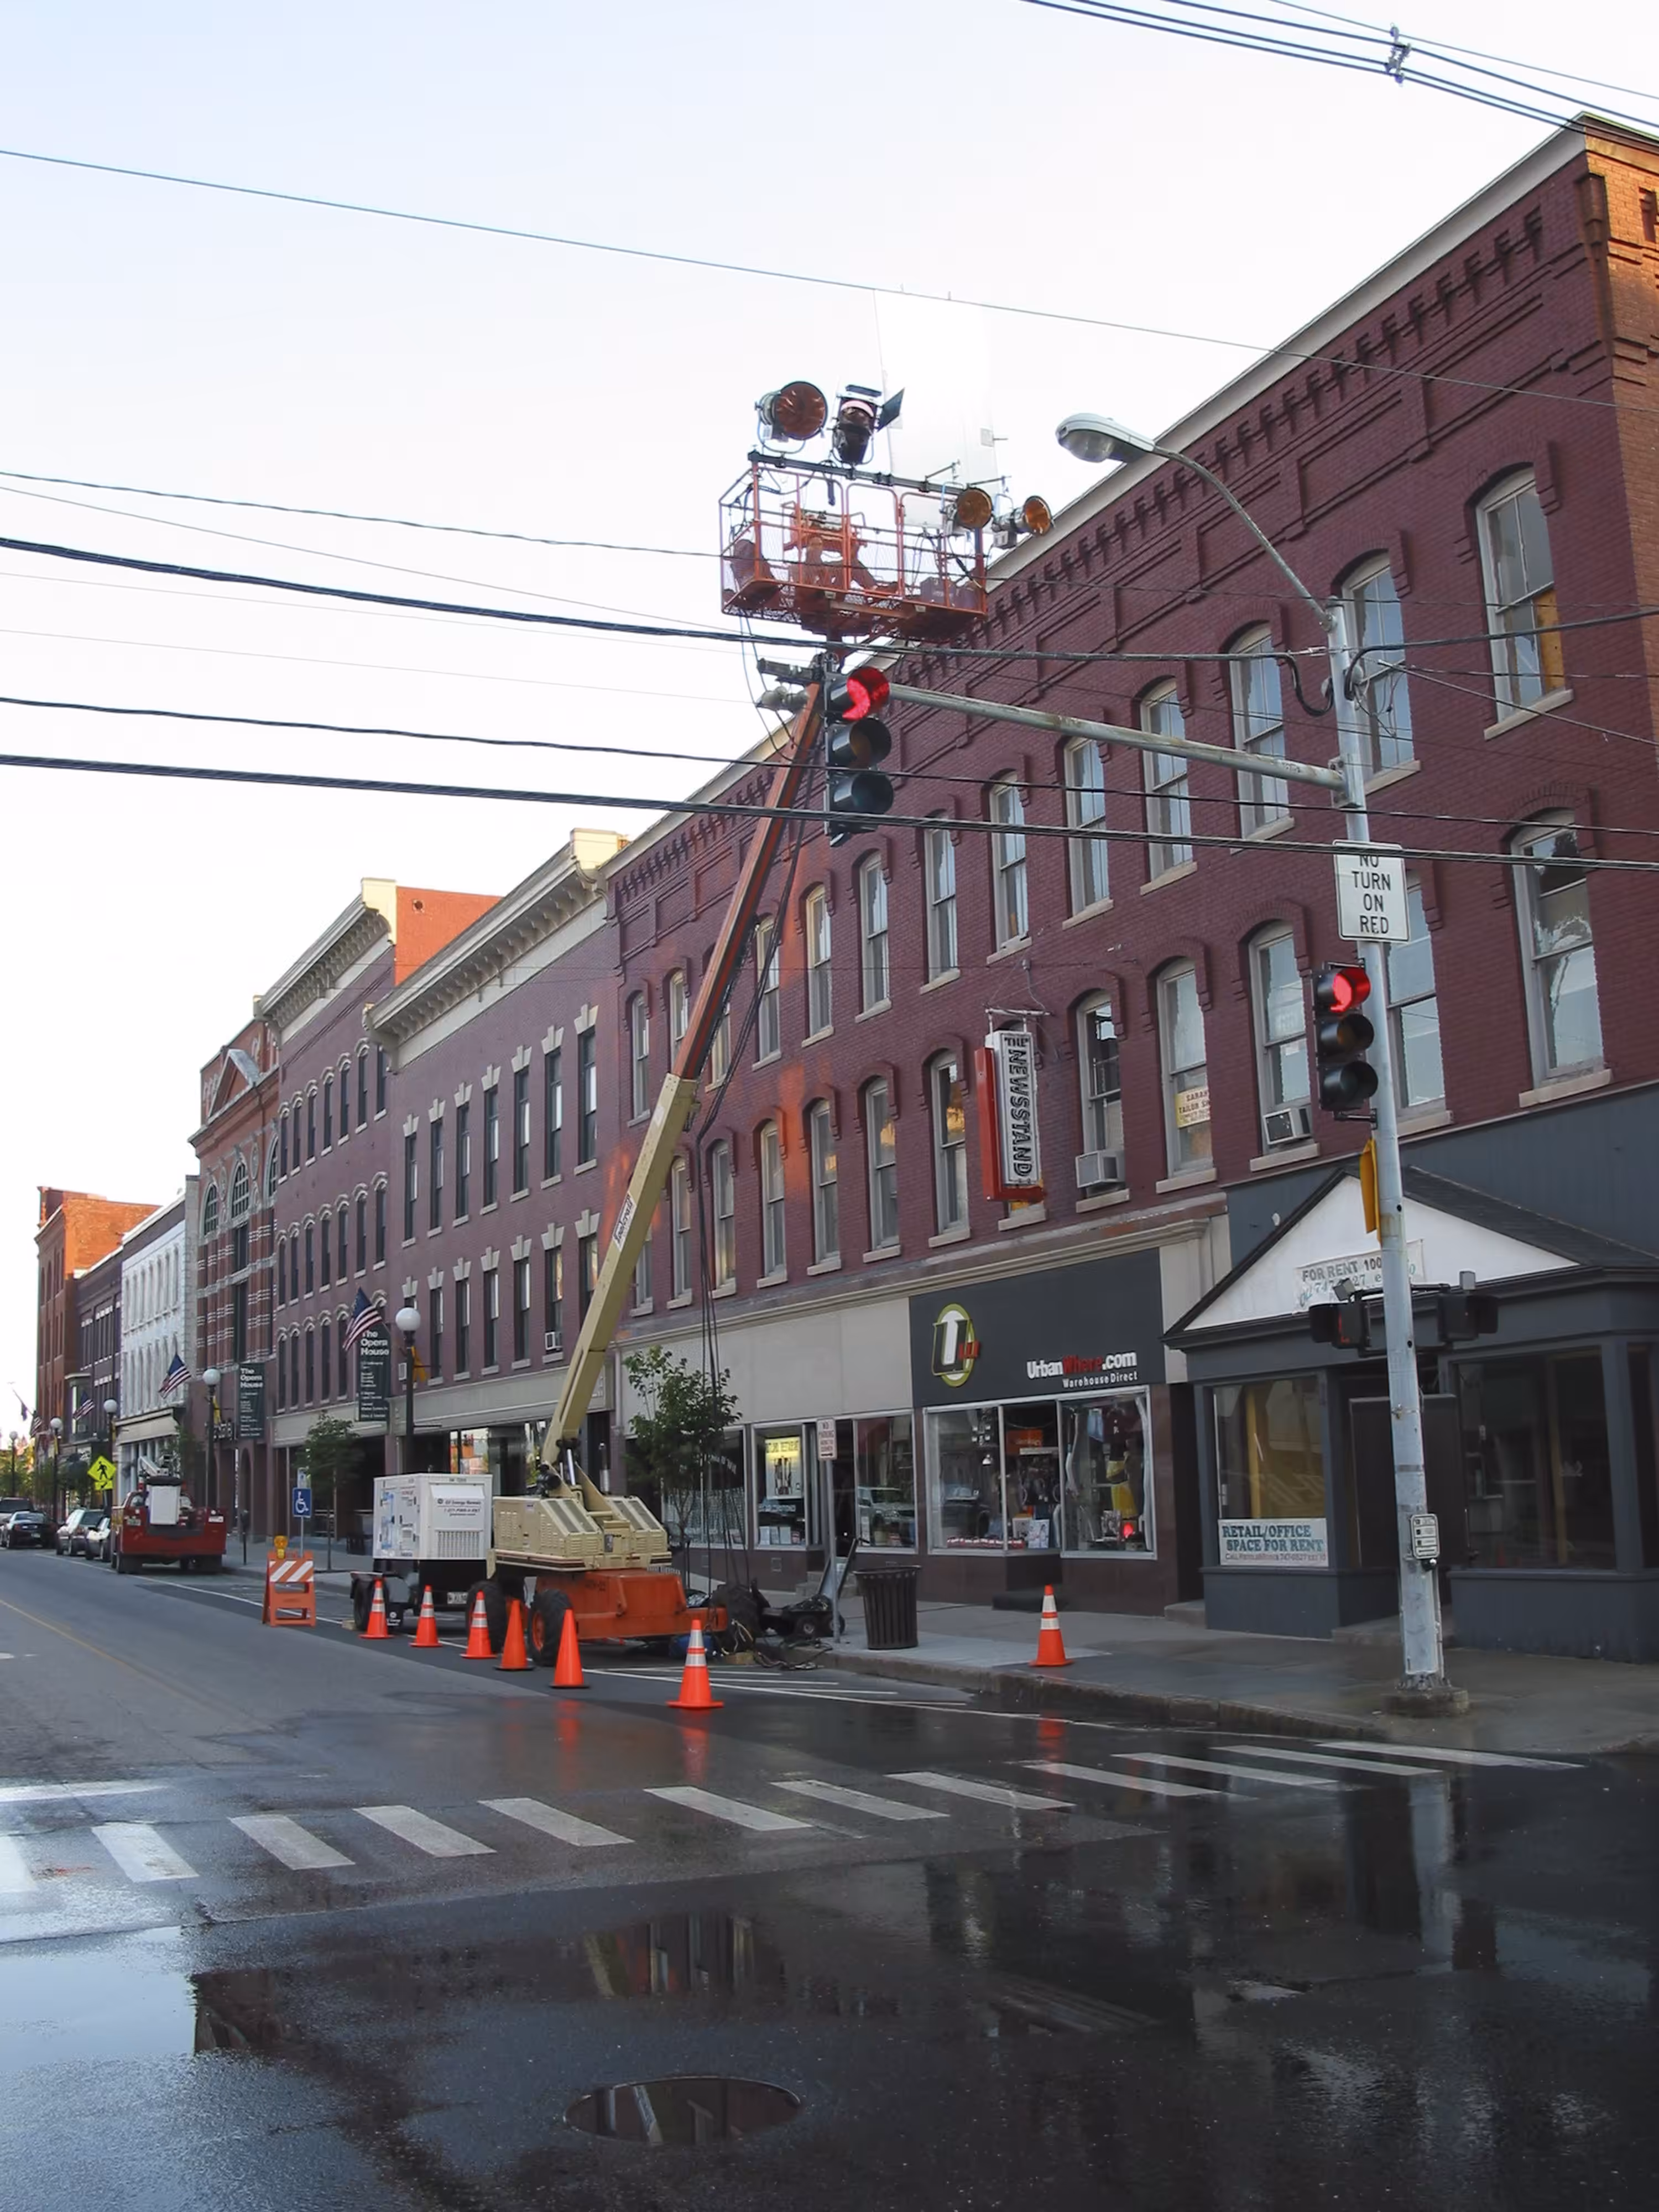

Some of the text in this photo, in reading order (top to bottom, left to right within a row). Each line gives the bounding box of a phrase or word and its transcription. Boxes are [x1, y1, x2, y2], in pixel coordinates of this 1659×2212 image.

[1360, 854, 1379, 868] NO
[1352, 871, 1391, 891] TURN
[1363, 893, 1383, 912] ON
[1360, 915, 1389, 935] RED
[1004, 1037, 1029, 1047] THE
[1008, 1050, 1032, 1177] NEWSSTAND
[1302, 1267, 1325, 1282] FOR
[1327, 1261, 1358, 1278] RENT
[361, 1339, 388, 1348] Opera
[361, 1348, 390, 1356] House
[1026, 1352, 1138, 1379] UrbanWhere.com
[1222, 1525, 1311, 1540] RETAIL/OFFICE
[1227, 1539, 1324, 1552] SPACE FOR RENT
